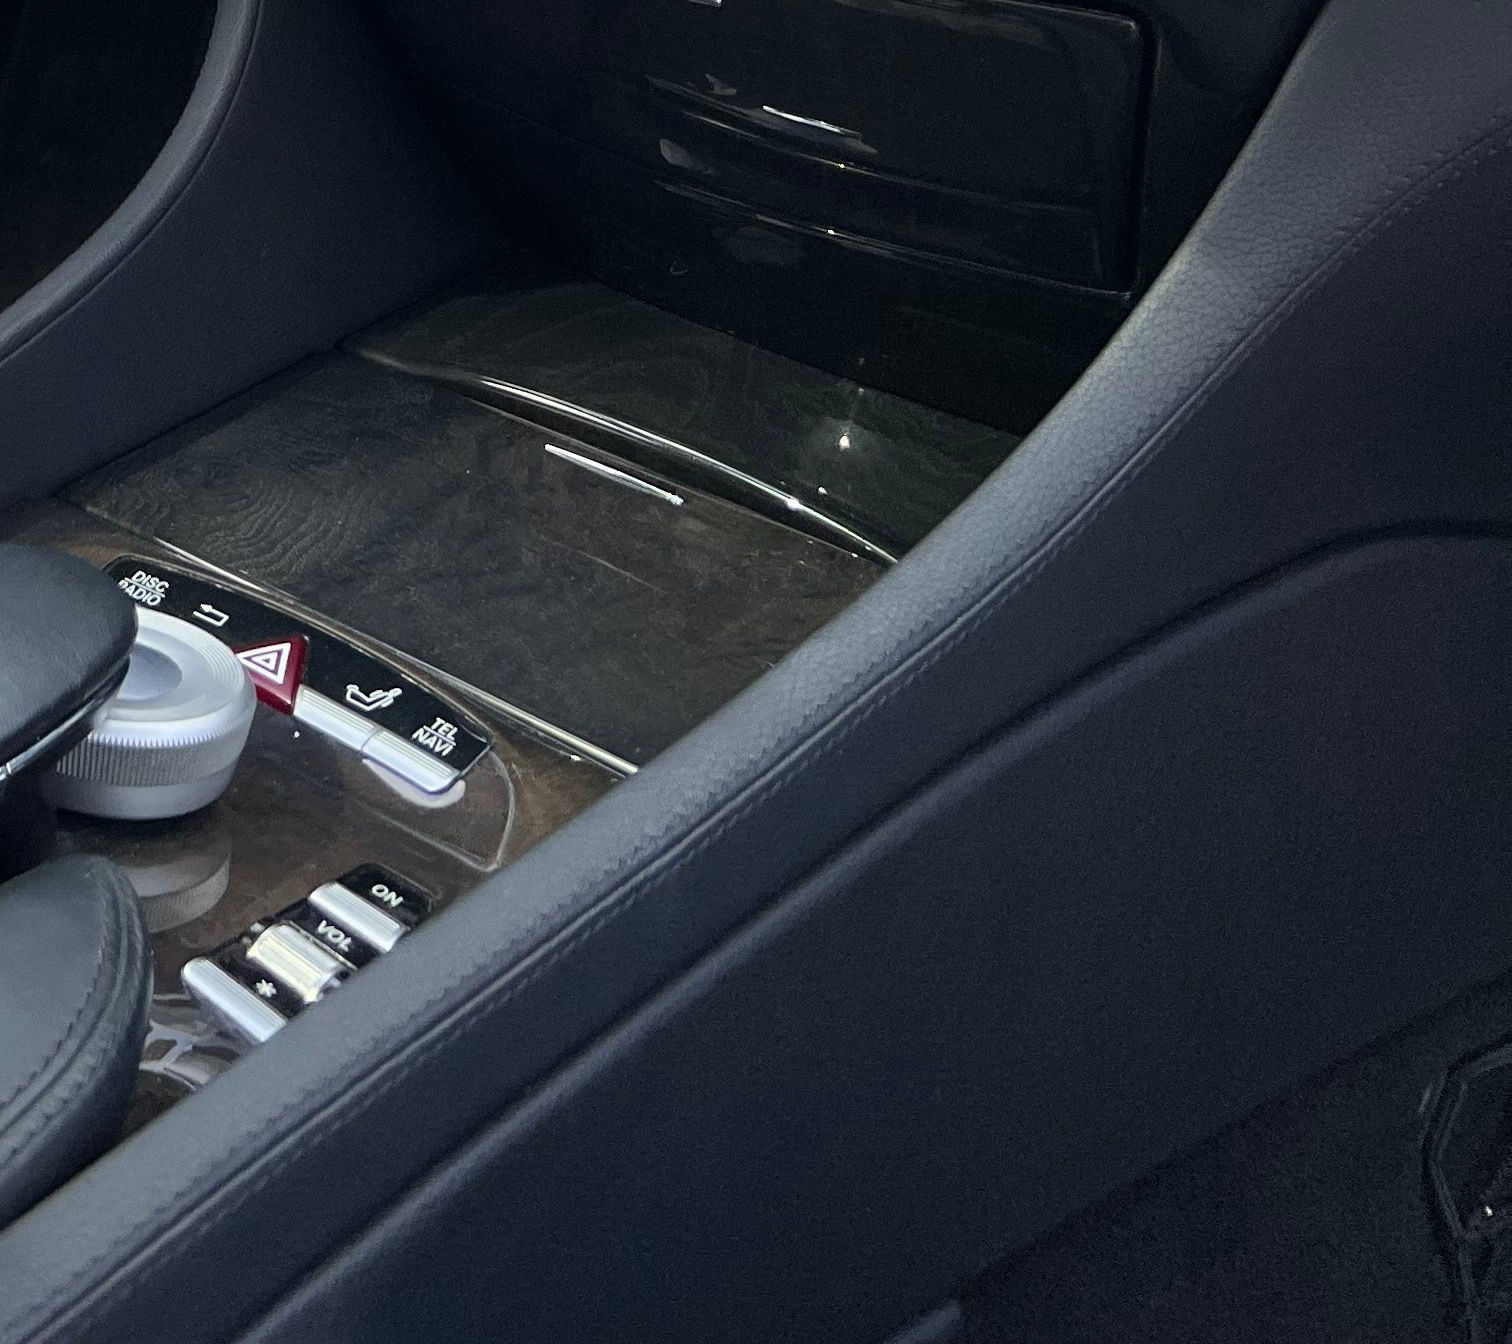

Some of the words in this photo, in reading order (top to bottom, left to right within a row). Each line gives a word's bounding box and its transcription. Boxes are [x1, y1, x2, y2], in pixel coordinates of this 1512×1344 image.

[118, 579, 162, 606] RADIO
[131, 570, 170, 593] DISC
[410, 727, 454, 756] NAVI
[431, 716, 459, 741] TEL
[371, 883, 404, 907] ON
[317, 919, 352, 952] VOL
